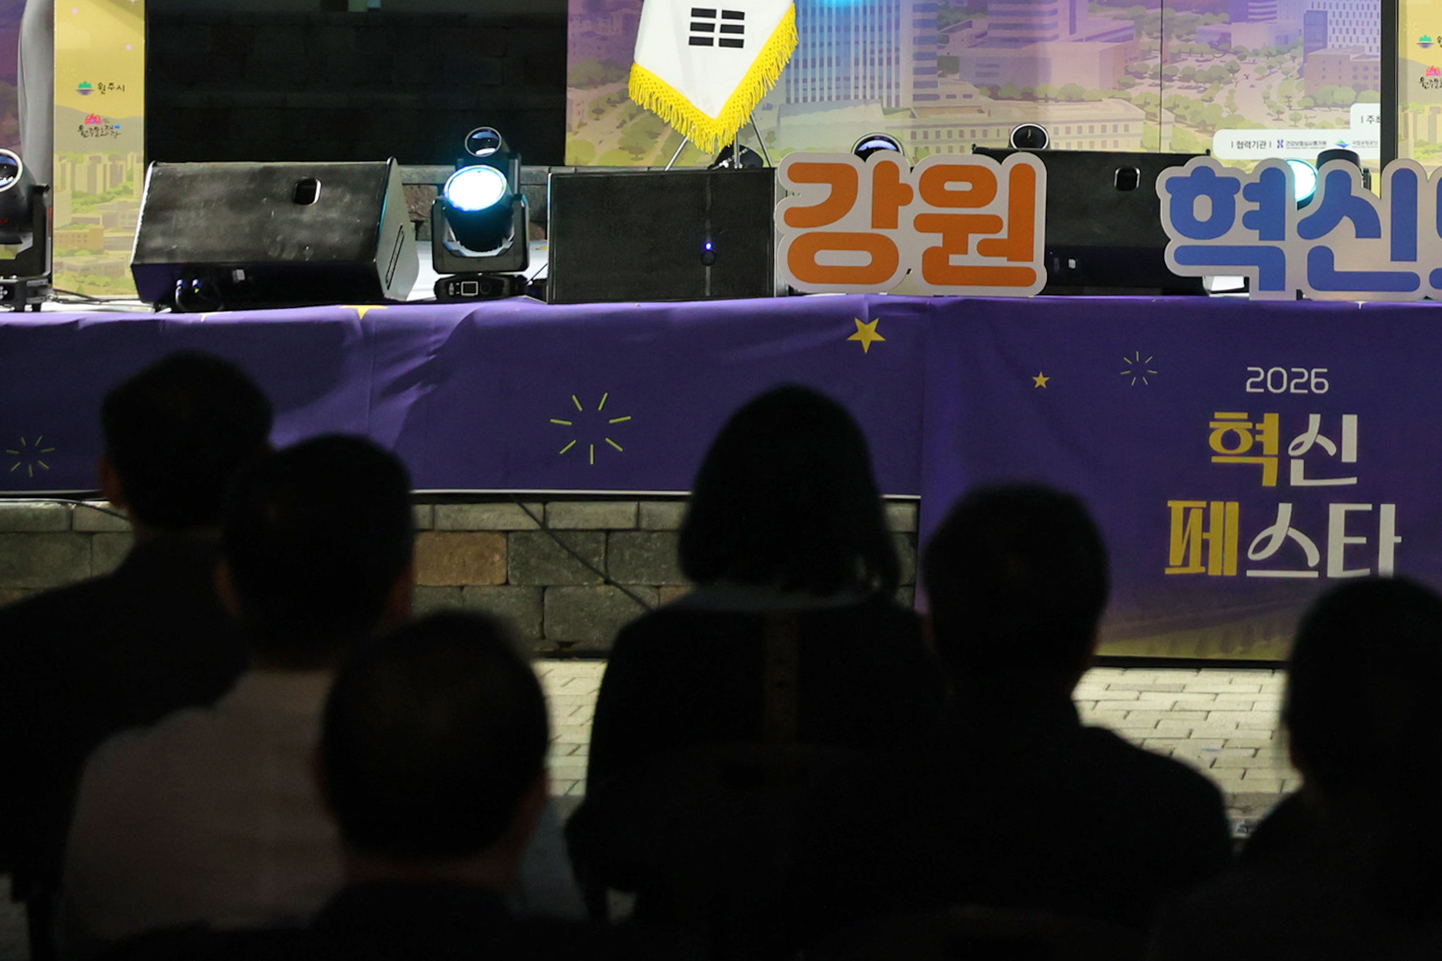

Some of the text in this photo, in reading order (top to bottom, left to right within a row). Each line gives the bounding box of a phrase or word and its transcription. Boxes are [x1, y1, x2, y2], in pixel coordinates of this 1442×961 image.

[97, 82, 125, 95] 원주시
[782, 159, 1038, 288] 강원
[1245, 366, 1330, 394] 2026
[1208, 411, 1358, 487] 혁신
[1164, 500, 1402, 579] 페스타
